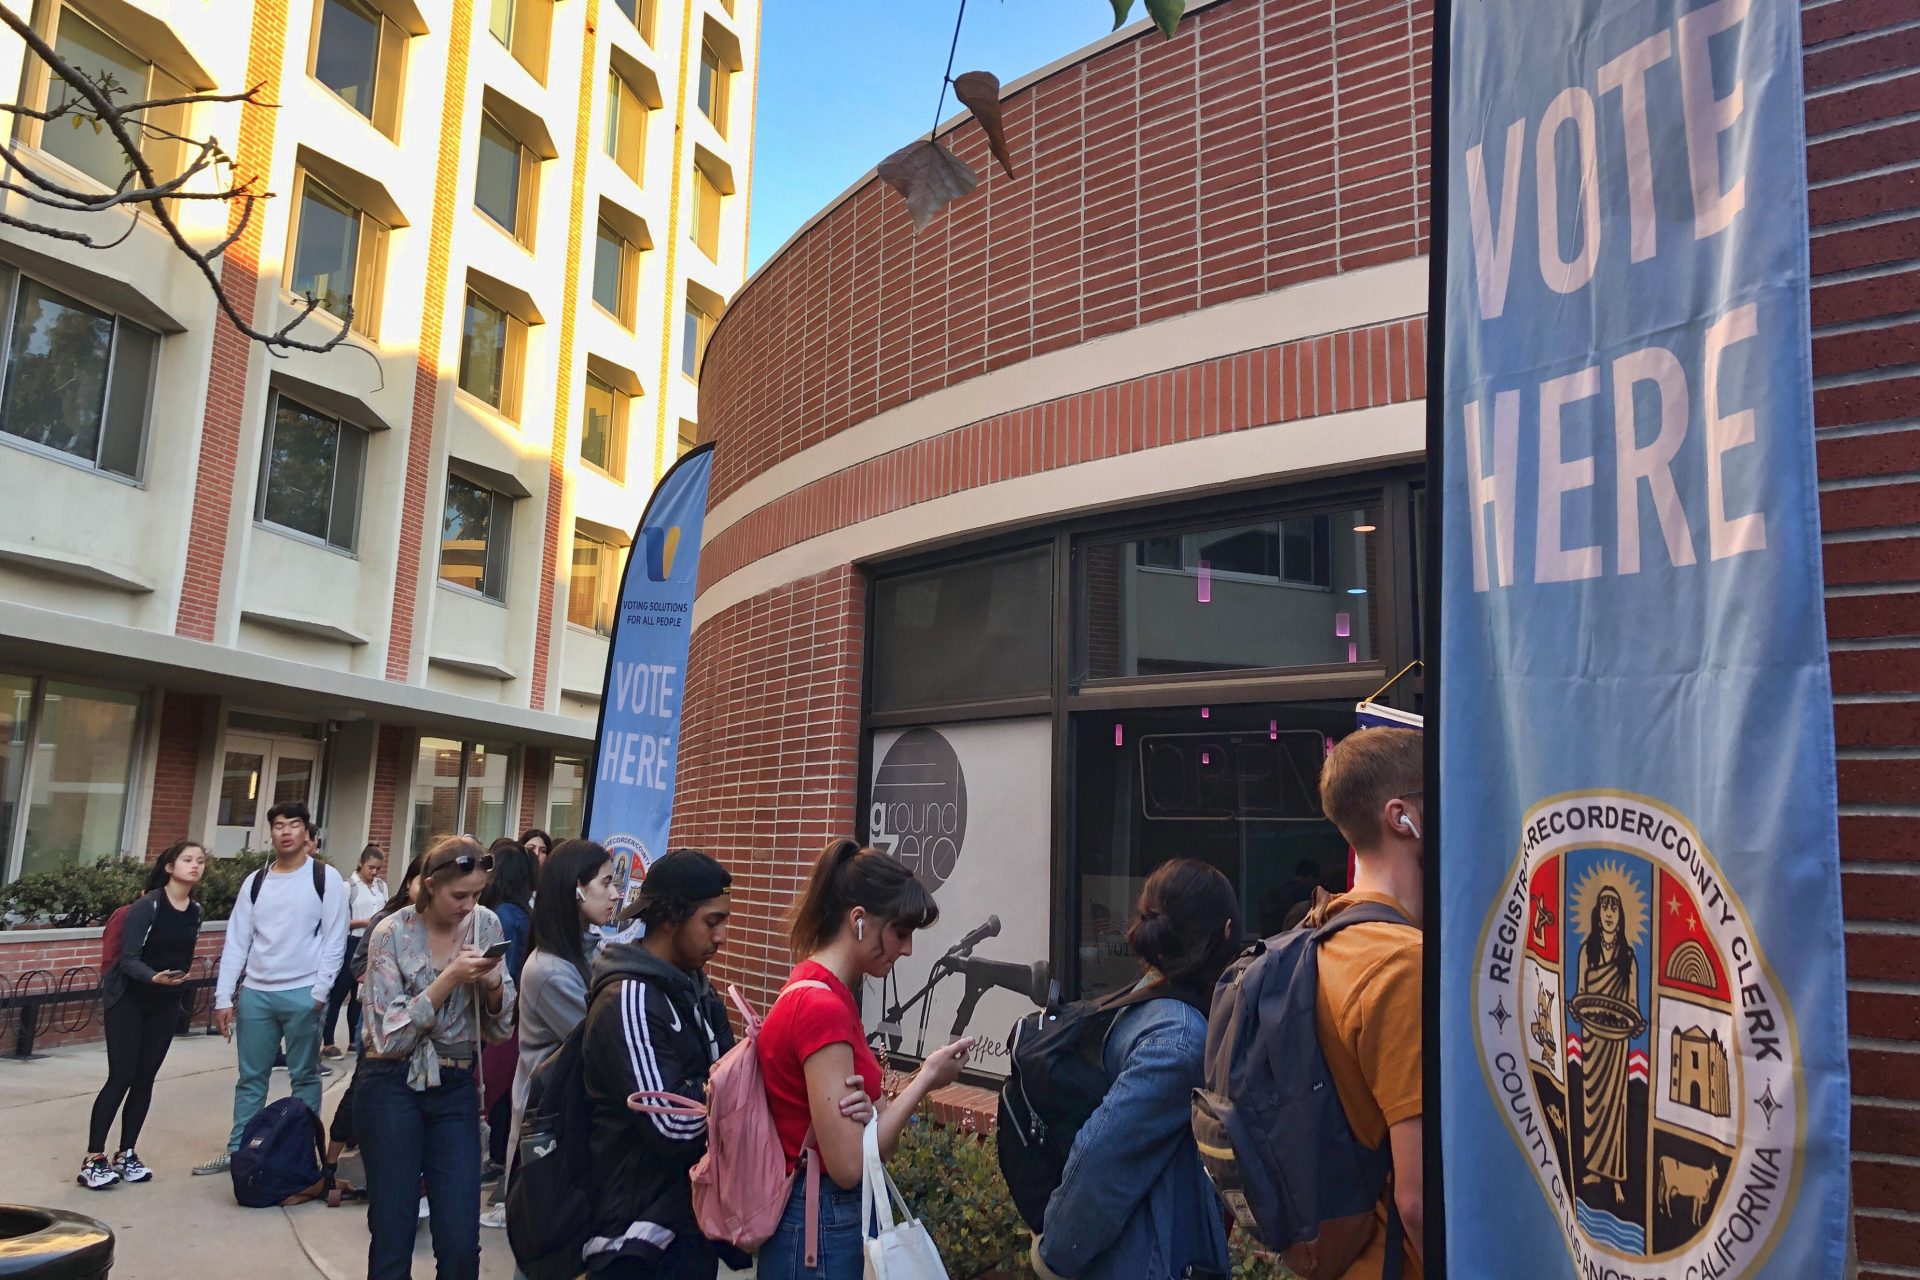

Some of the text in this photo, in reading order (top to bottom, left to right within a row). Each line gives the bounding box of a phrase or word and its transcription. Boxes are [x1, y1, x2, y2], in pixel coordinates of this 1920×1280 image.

[1466, 0, 1752, 320] VOTE
[1464, 302, 1766, 592] HERE
[623, 601, 688, 612] VOTING SOLUTIONS
[627, 616, 682, 627] FOR ALL PEOPLE
[616, 661, 676, 718] VOTE
[601, 731, 671, 790] HERE
[1149, 743, 1320, 812] OPEN
[1731, 936, 1782, 1063] CLERK
[968, 1035, 1011, 1064] offee
[1495, 1052, 1553, 1169] COUNTY
[1551, 1174, 1566, 1209] OF
